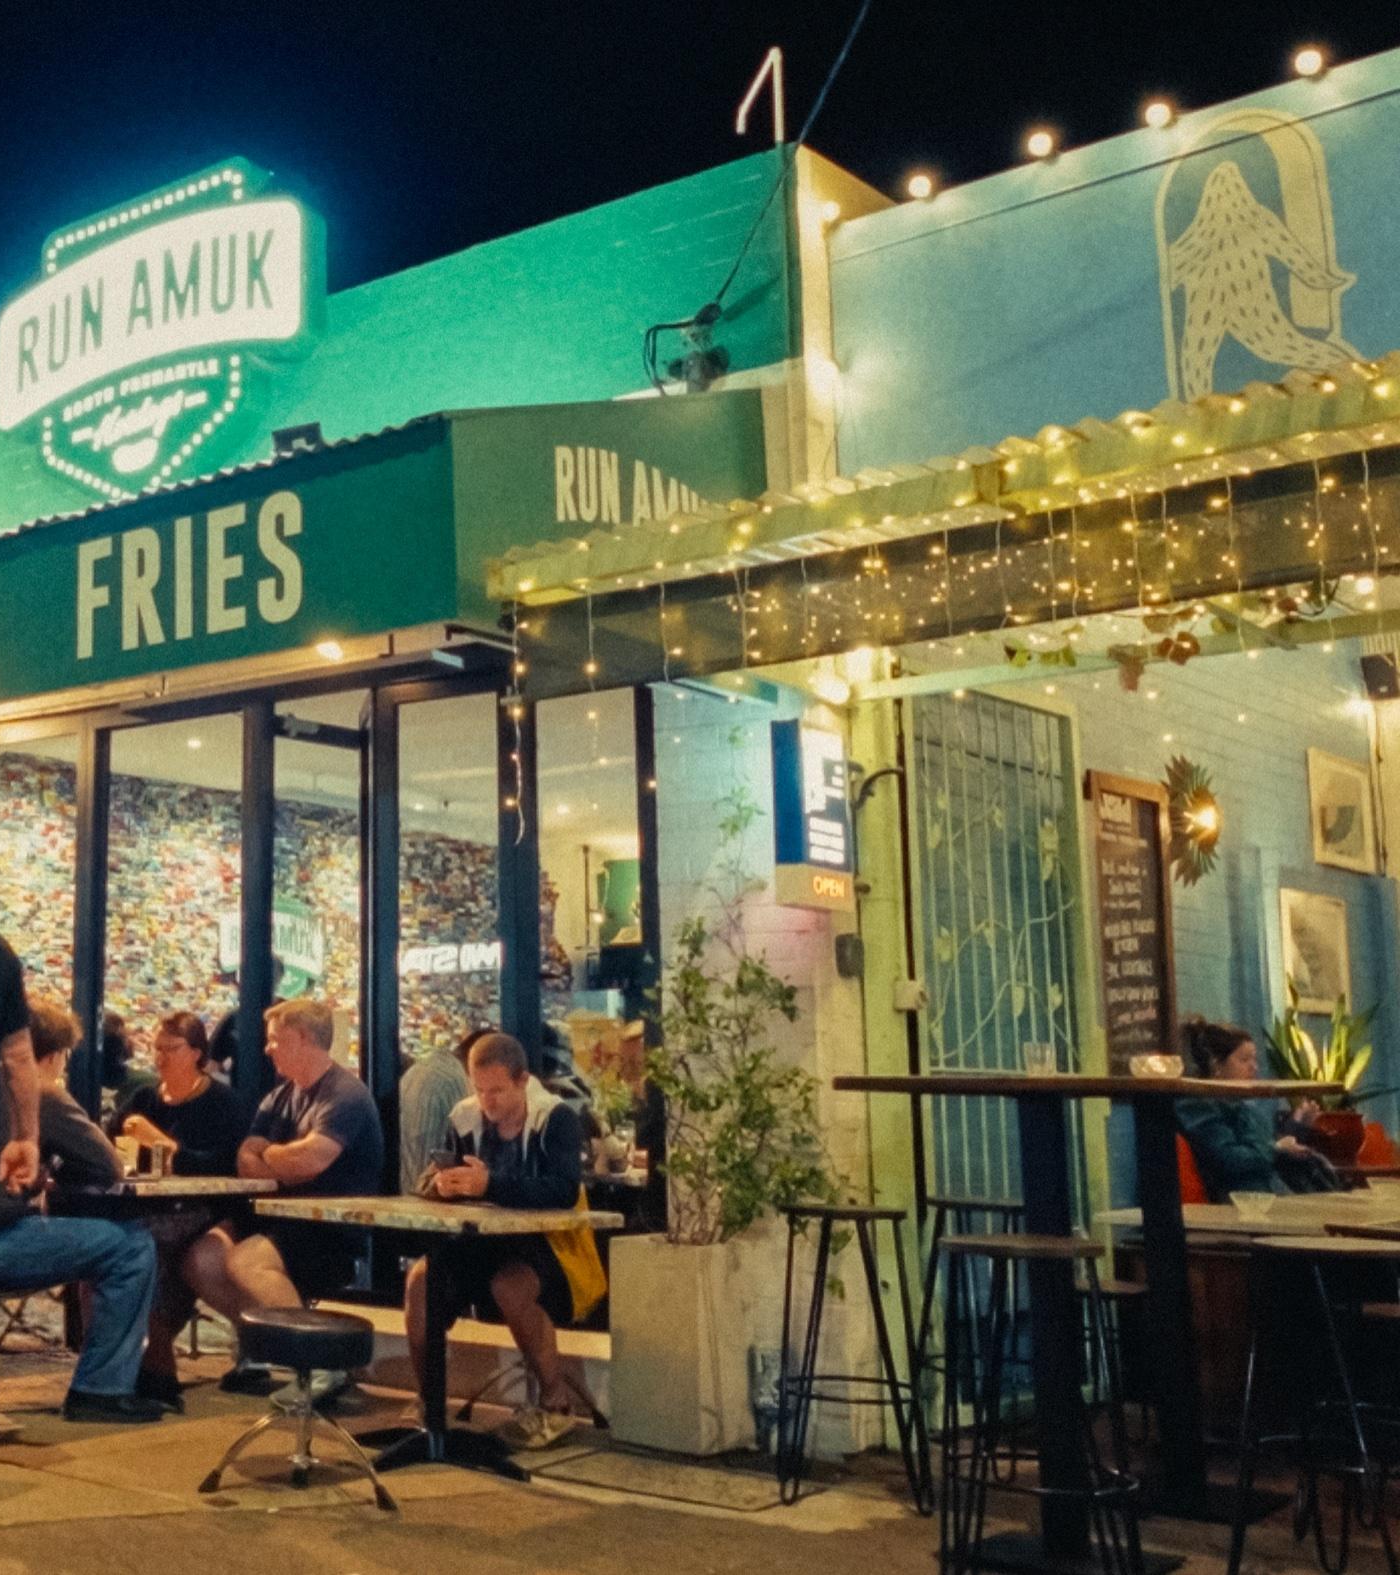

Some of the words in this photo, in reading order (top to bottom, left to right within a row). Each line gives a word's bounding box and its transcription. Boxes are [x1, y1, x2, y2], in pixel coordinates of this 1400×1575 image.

[18, 277, 104, 394] RUN
[127, 229, 275, 336] AMUK
[555, 446, 621, 524] RUN
[76, 491, 303, 660] FRIES
[813, 876, 845, 898] OPEN
